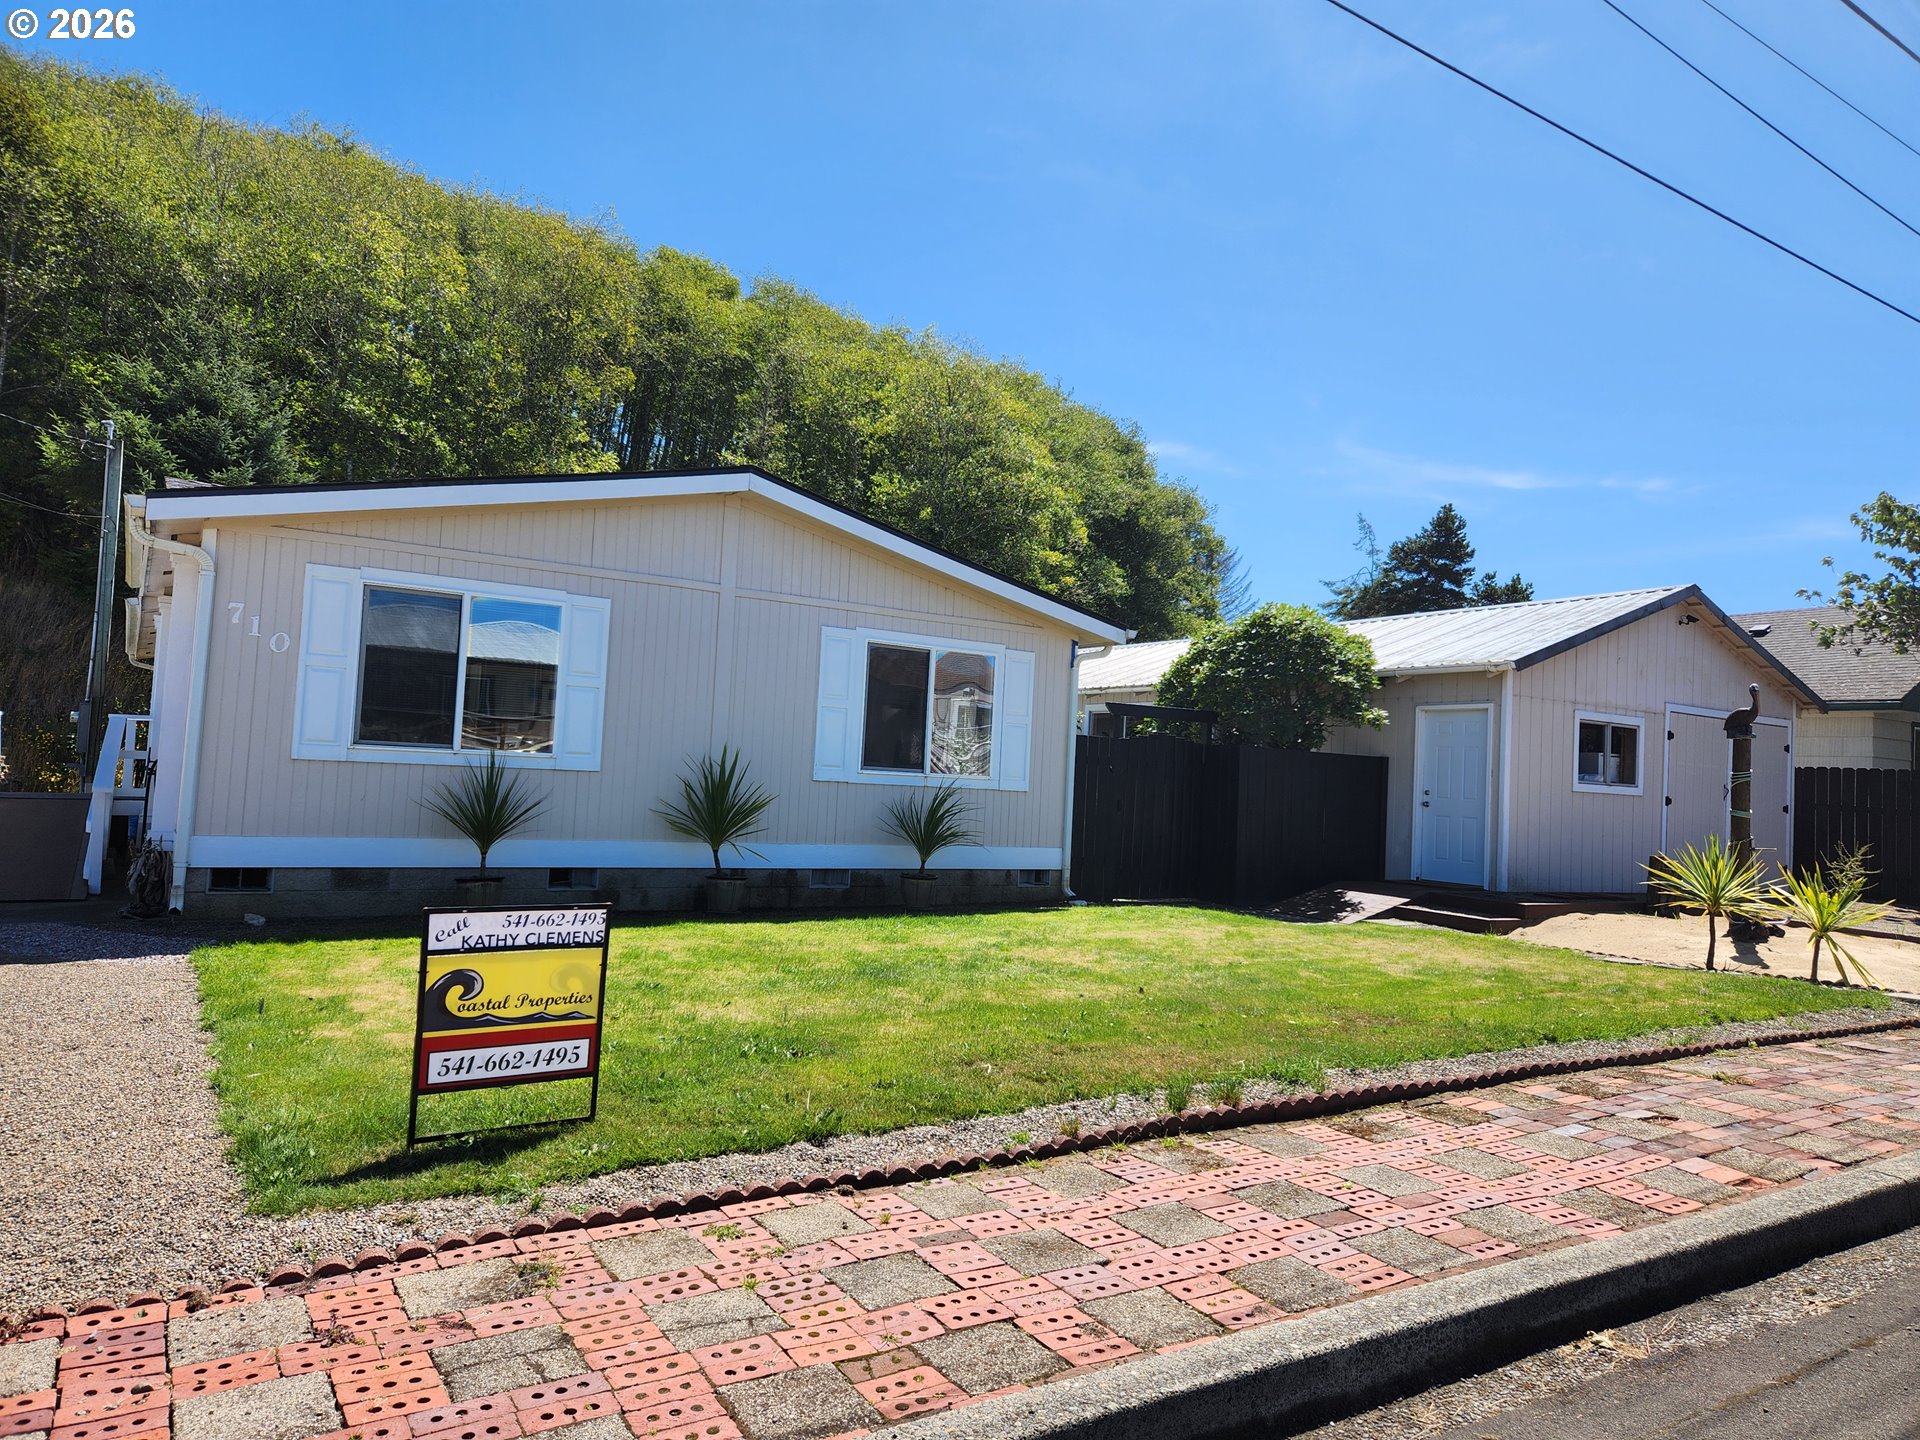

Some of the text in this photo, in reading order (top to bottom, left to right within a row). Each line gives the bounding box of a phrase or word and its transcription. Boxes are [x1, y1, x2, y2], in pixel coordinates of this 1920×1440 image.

[228, 602, 290, 653] 710
[435, 916, 471, 942] Call
[502, 911, 607, 928] 541-662-1495
[461, 929, 604, 949] KATHY CLEMENS
[514, 991, 594, 1011] Properties
[436, 1045, 582, 1078] 541-662-1495
